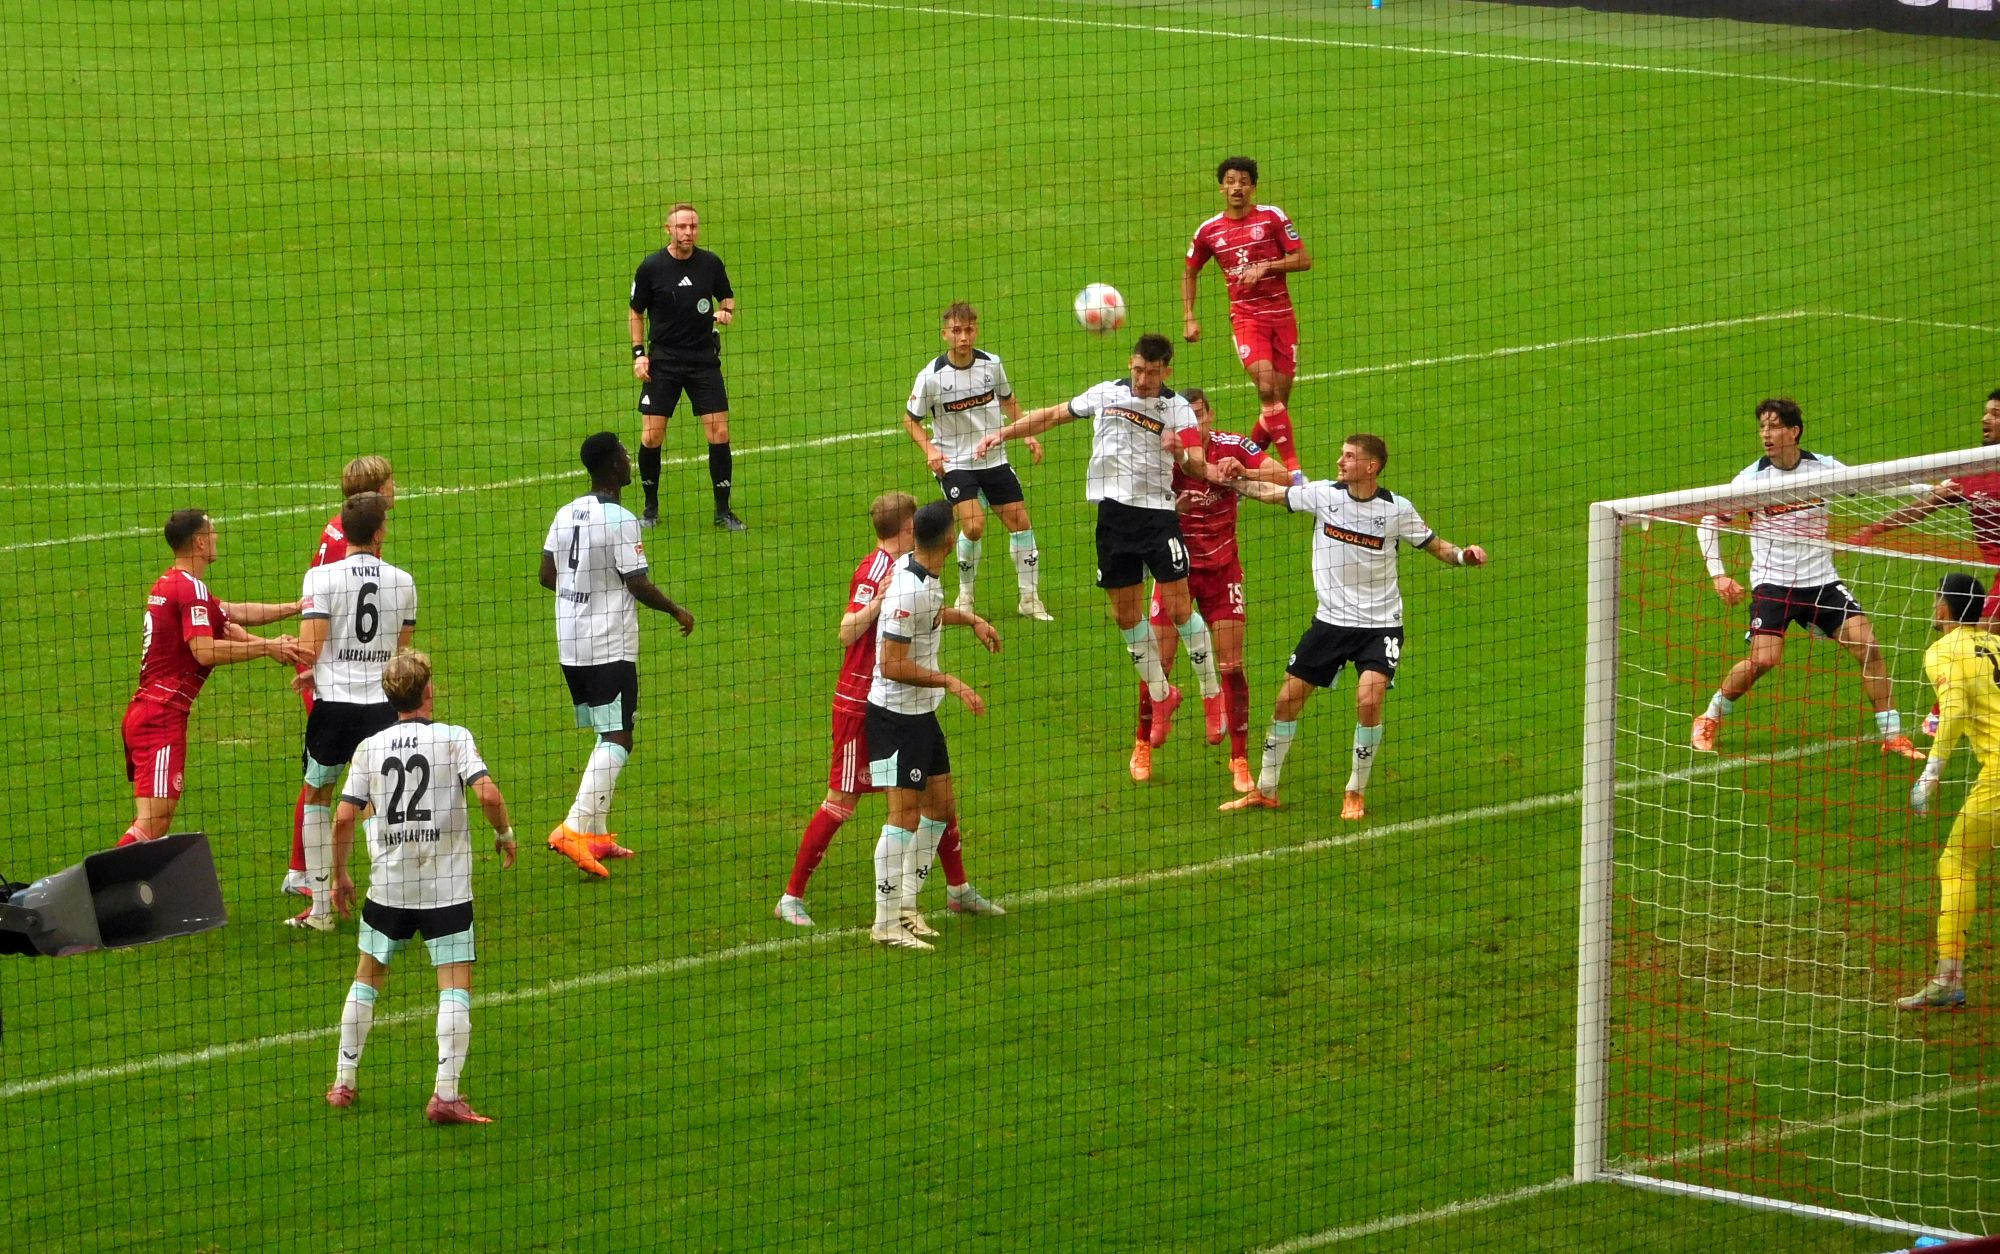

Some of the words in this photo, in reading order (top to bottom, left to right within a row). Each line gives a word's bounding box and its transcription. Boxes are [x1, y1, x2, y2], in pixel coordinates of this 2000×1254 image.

[1104, 408, 1161, 431] NOVOLINE
[1325, 527, 1380, 547] NOVOLINE
[569, 525, 580, 582] 4
[1228, 583, 1243, 604] 15
[355, 582, 378, 643] 6
[1384, 636, 1399, 659] 26
[391, 736, 418, 751] HAAS
[381, 754, 431, 825] 22
